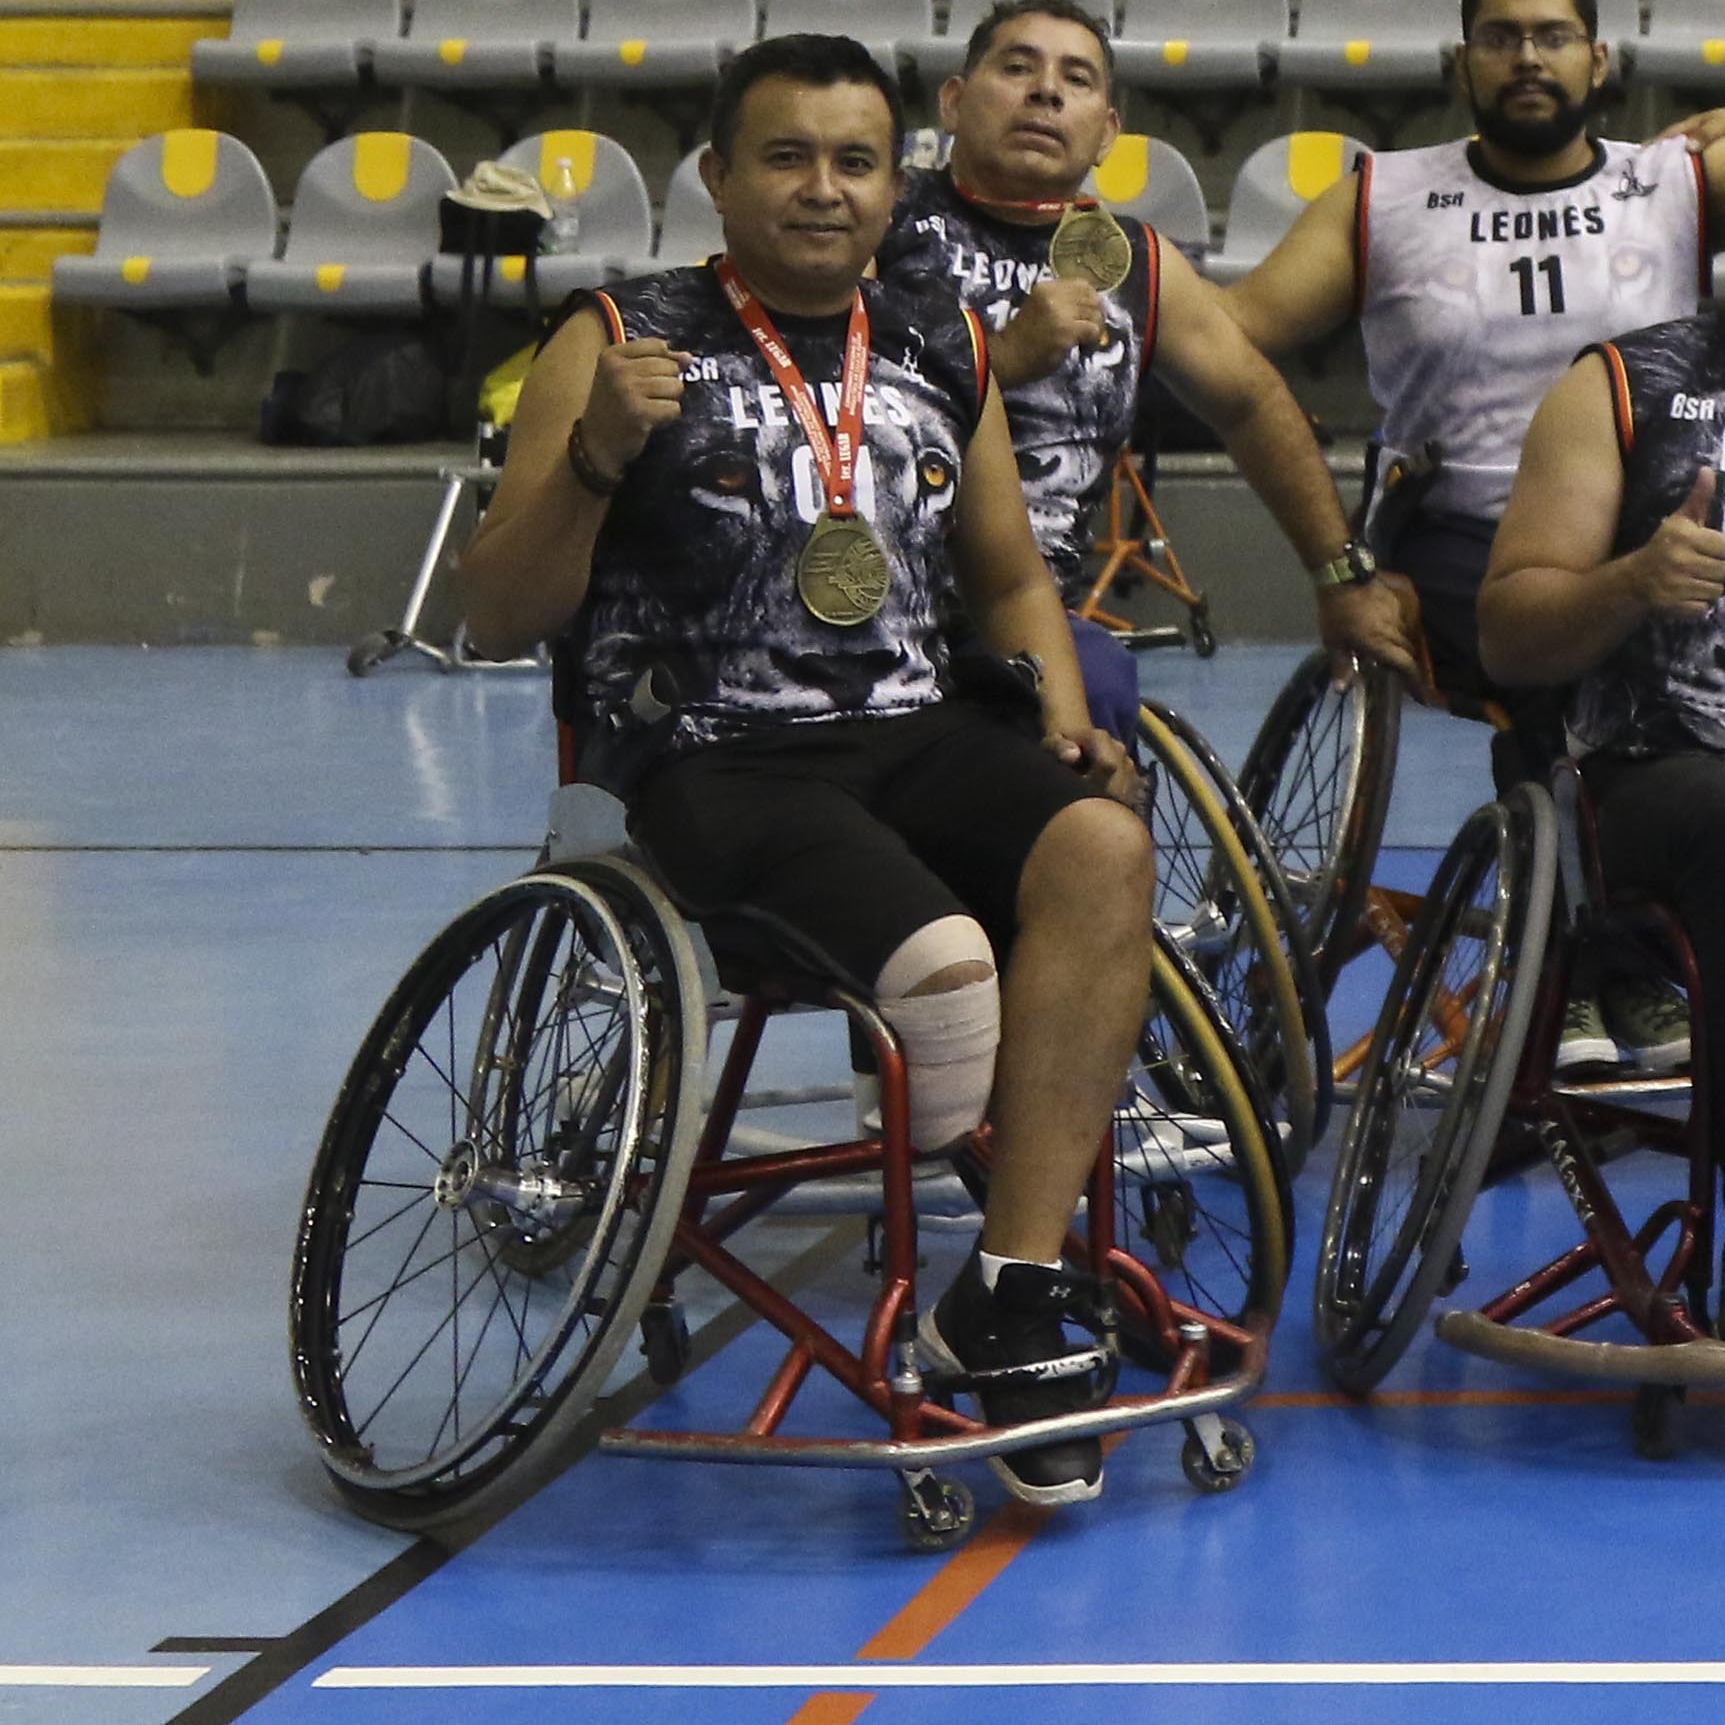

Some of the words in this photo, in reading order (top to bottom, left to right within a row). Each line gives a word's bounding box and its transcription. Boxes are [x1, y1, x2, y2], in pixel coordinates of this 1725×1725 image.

[1427, 191, 1465, 209] BSR
[1470, 205, 1605, 243] LEONES
[1509, 254, 1565, 316] 11
[679, 356, 719, 382] SR
[729, 381, 912, 429] LENES
[1670, 392, 1715, 421] BSR
